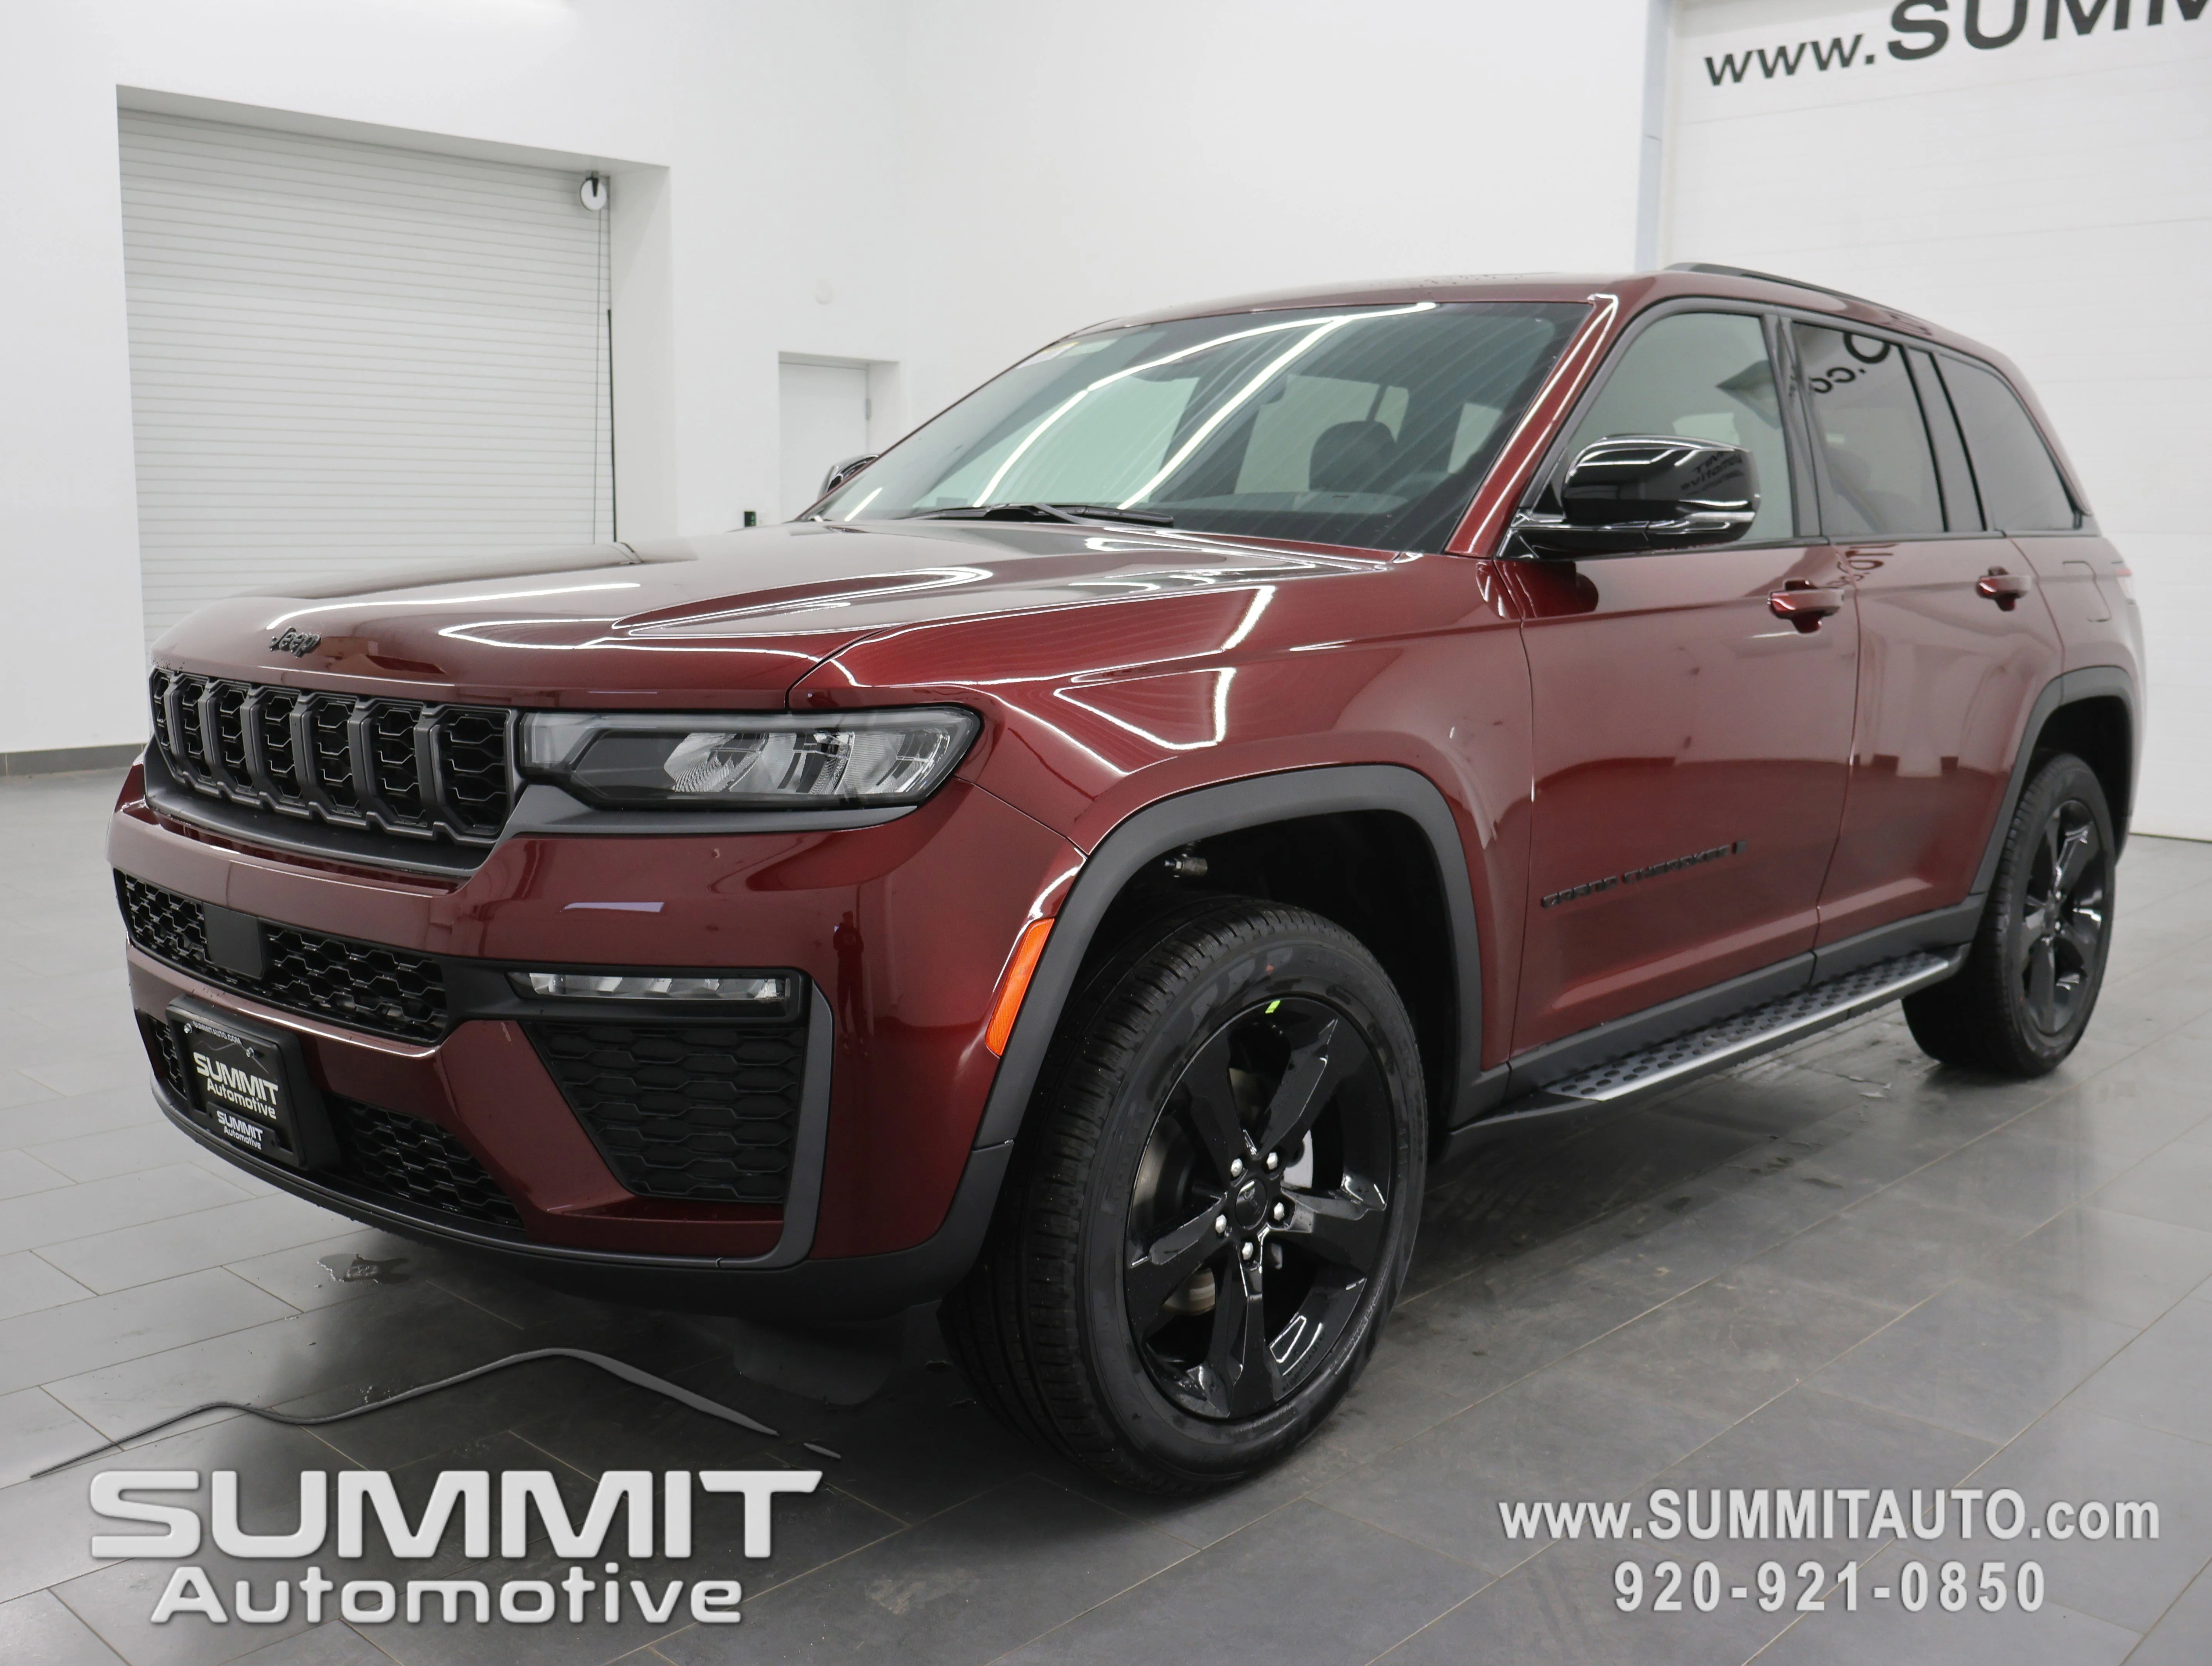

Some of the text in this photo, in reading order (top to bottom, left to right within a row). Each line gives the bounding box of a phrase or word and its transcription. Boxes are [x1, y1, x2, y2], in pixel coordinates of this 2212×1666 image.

[269, 626, 322, 658] Jeep
[1540, 845, 1730, 908] GRAND CHEROKEE
[192, 1020, 242, 1045] SUMMITAUTO.COM
[193, 1052, 278, 1106] SUMMIT
[207, 1077, 277, 1120] Automotive
[216, 1110, 263, 1142] SUMMIT
[224, 1126, 262, 1150] Automotive
